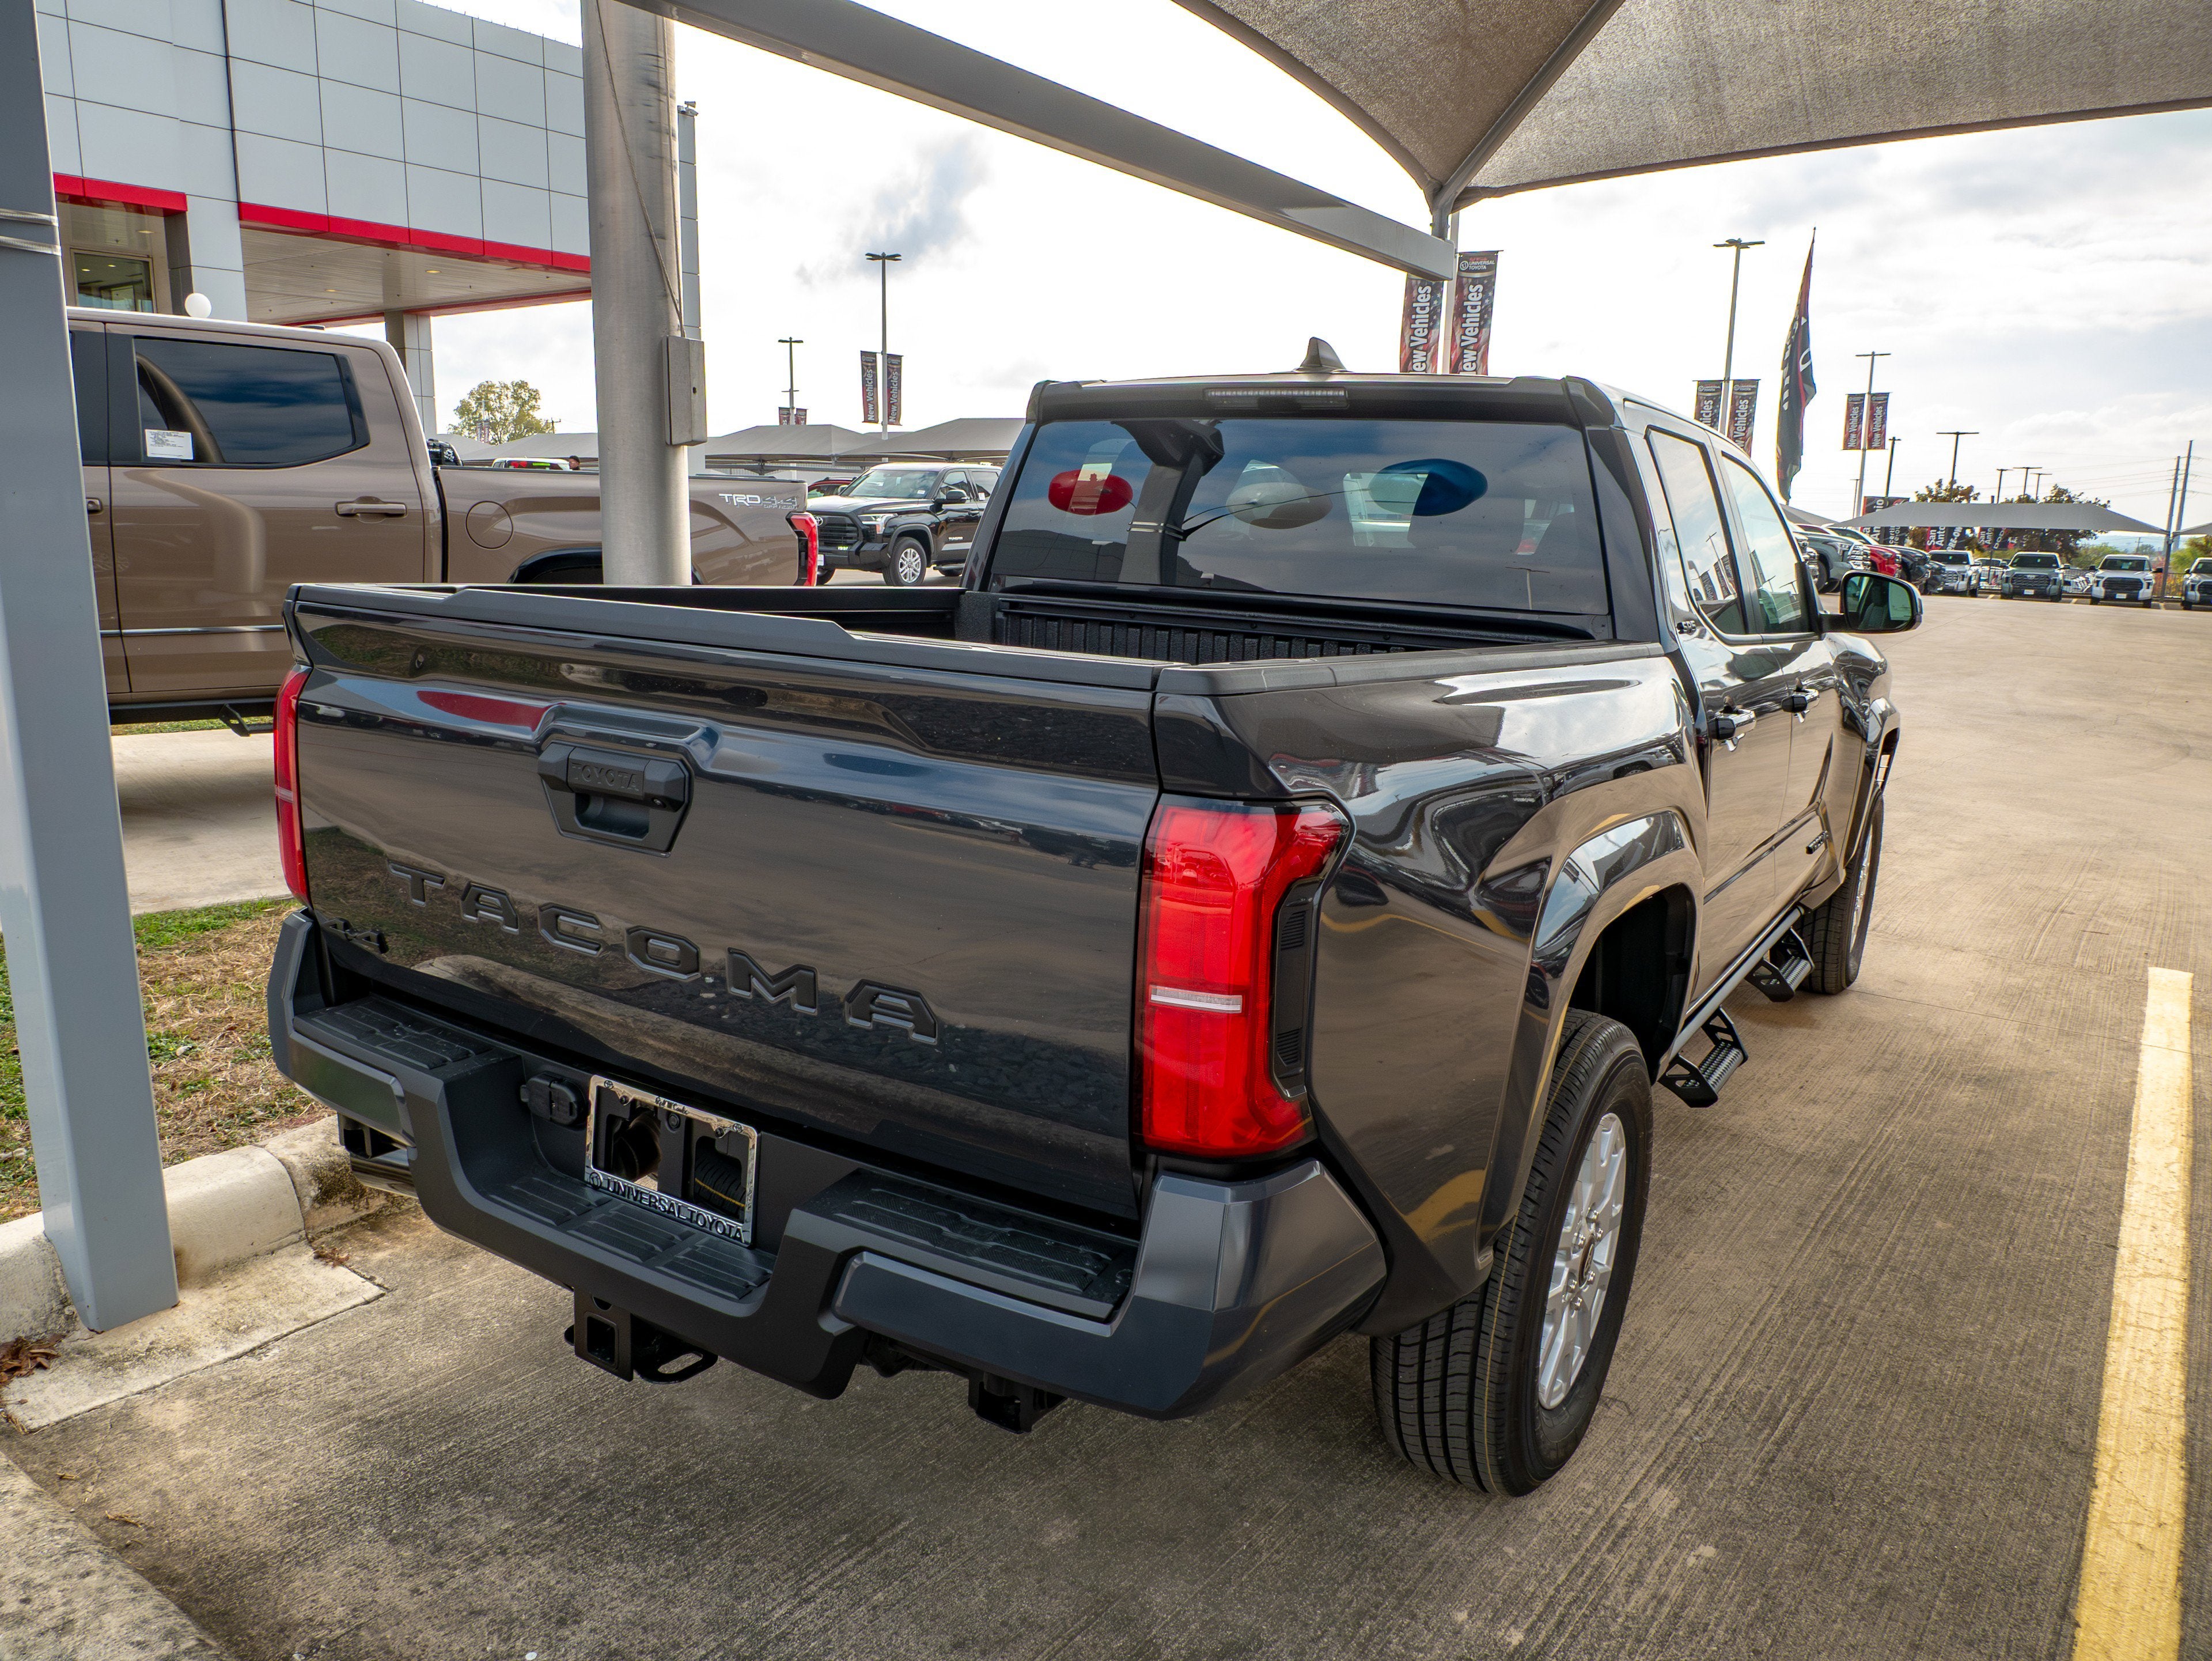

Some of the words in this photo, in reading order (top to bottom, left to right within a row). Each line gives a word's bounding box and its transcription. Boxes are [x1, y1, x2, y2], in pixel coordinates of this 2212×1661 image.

[1410, 286, 1431, 347] Vehicles
[1460, 284, 1483, 347] Vehicles
[1411, 350, 1427, 373] ew
[1461, 350, 1477, 374] ew
[865, 369, 873, 402] Vehicles
[890, 371, 898, 403] Vehicles
[889, 405, 897, 422] New
[1733, 399, 1749, 438] Vehicles
[1849, 406, 1859, 433] Vehicles
[1872, 406, 1883, 432] Vehicles
[1848, 433, 1857, 447] New
[1872, 433, 1881, 447] New
[719, 493, 761, 506] TRD
[1927, 529, 1937, 546] San
[1936, 527, 1945, 546] Anto
[572, 762, 639, 792] TOYOTA
[388, 860, 938, 1045] TACOMA
[607, 1176, 687, 1220] UNIVERSAL
[688, 1207, 745, 1244] TOYOTA
